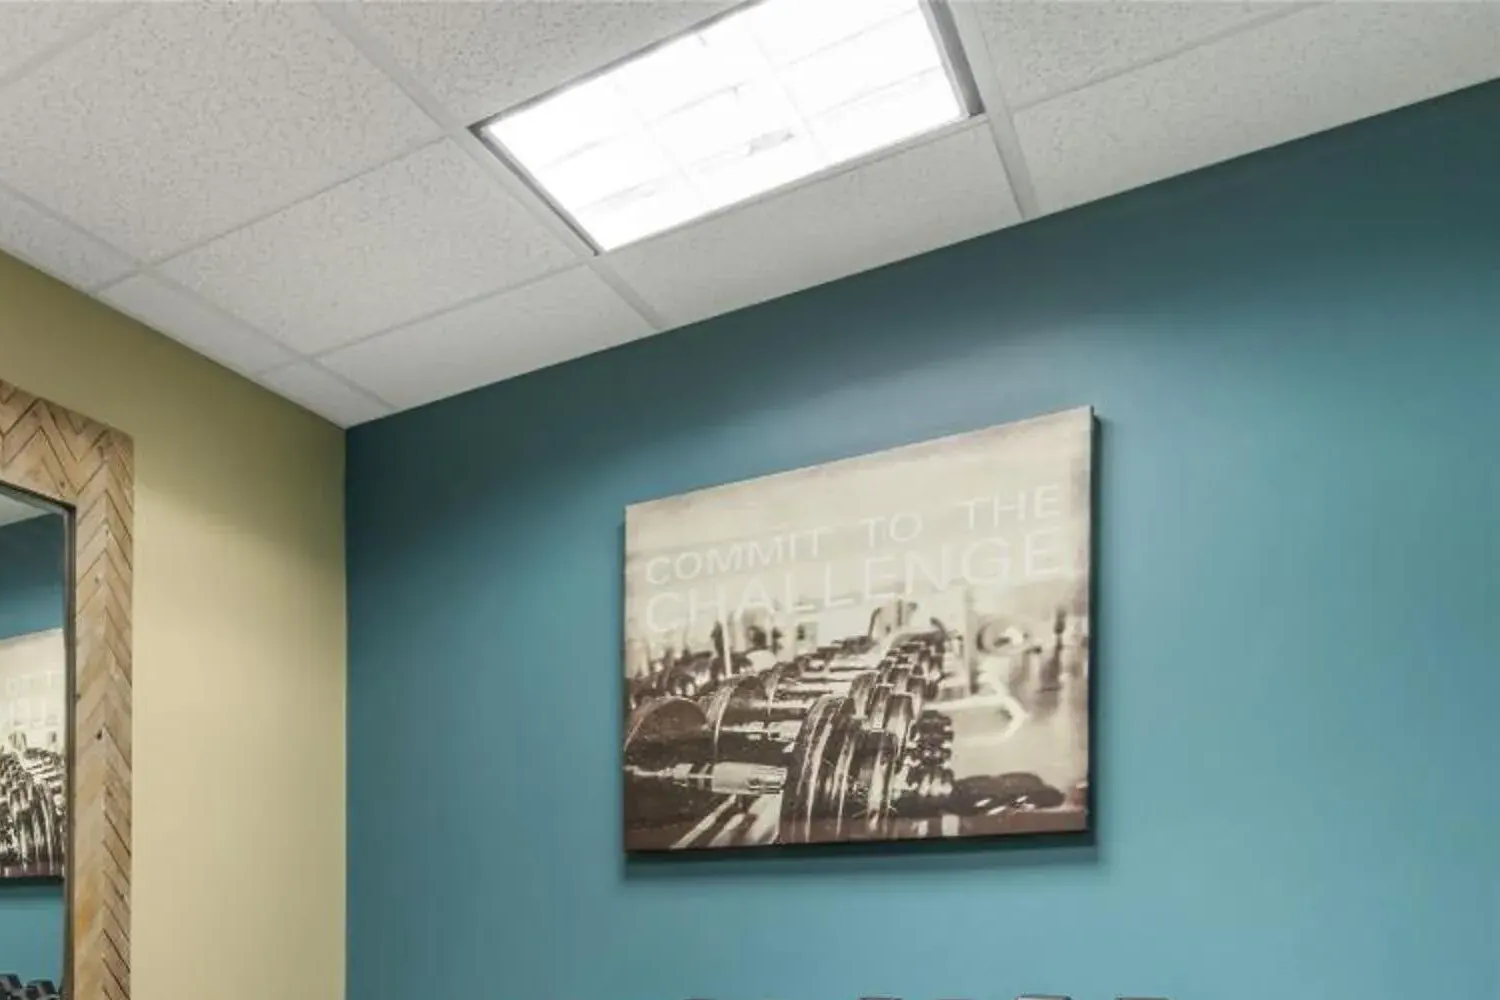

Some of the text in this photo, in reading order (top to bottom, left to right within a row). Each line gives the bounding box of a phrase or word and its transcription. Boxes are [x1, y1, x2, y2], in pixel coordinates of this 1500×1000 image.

[645, 484, 1062, 585] COMMIT TO THE
[645, 527, 1062, 633] CHALLENGE
